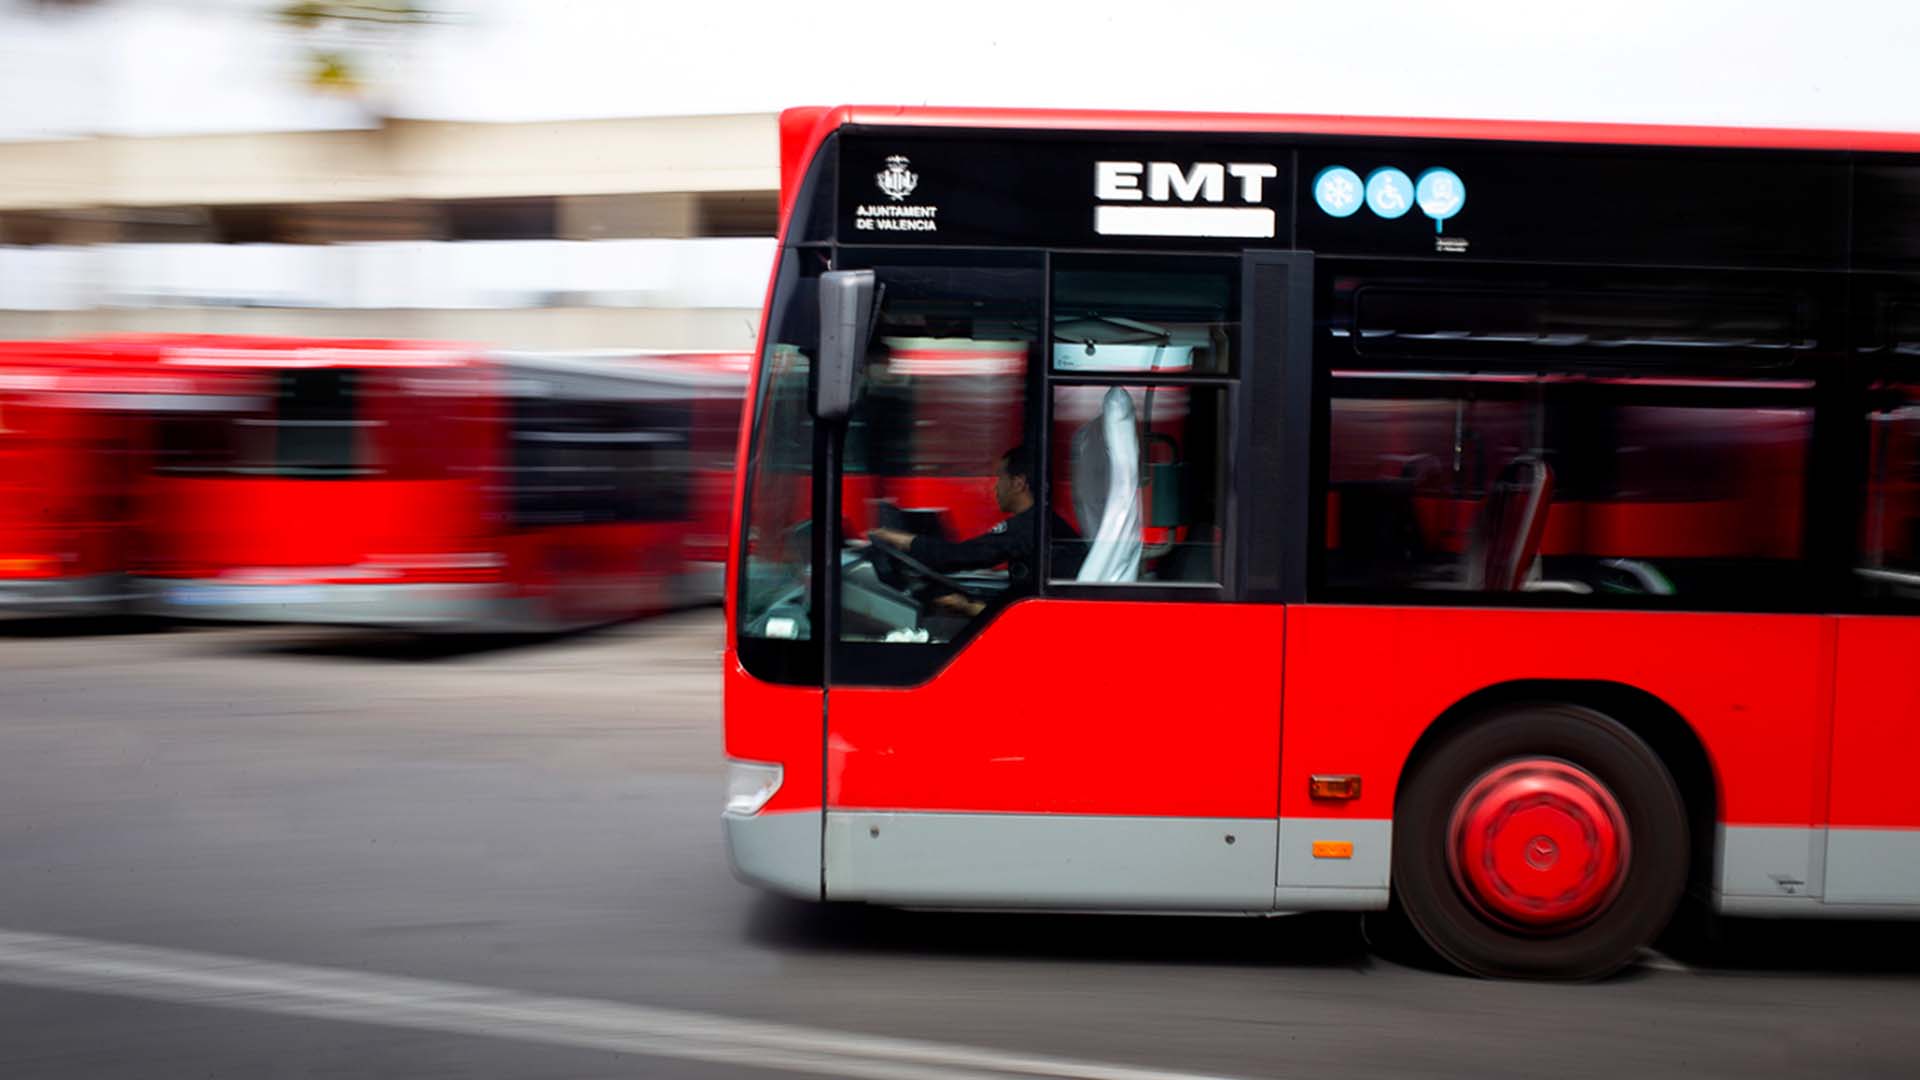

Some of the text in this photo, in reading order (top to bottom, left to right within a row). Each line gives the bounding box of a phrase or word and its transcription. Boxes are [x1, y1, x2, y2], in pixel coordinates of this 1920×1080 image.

[1095, 161, 1277, 202] EMT
[856, 205, 937, 218] AJUNTAMENT
[856, 218, 937, 231] DE VALENCIA
